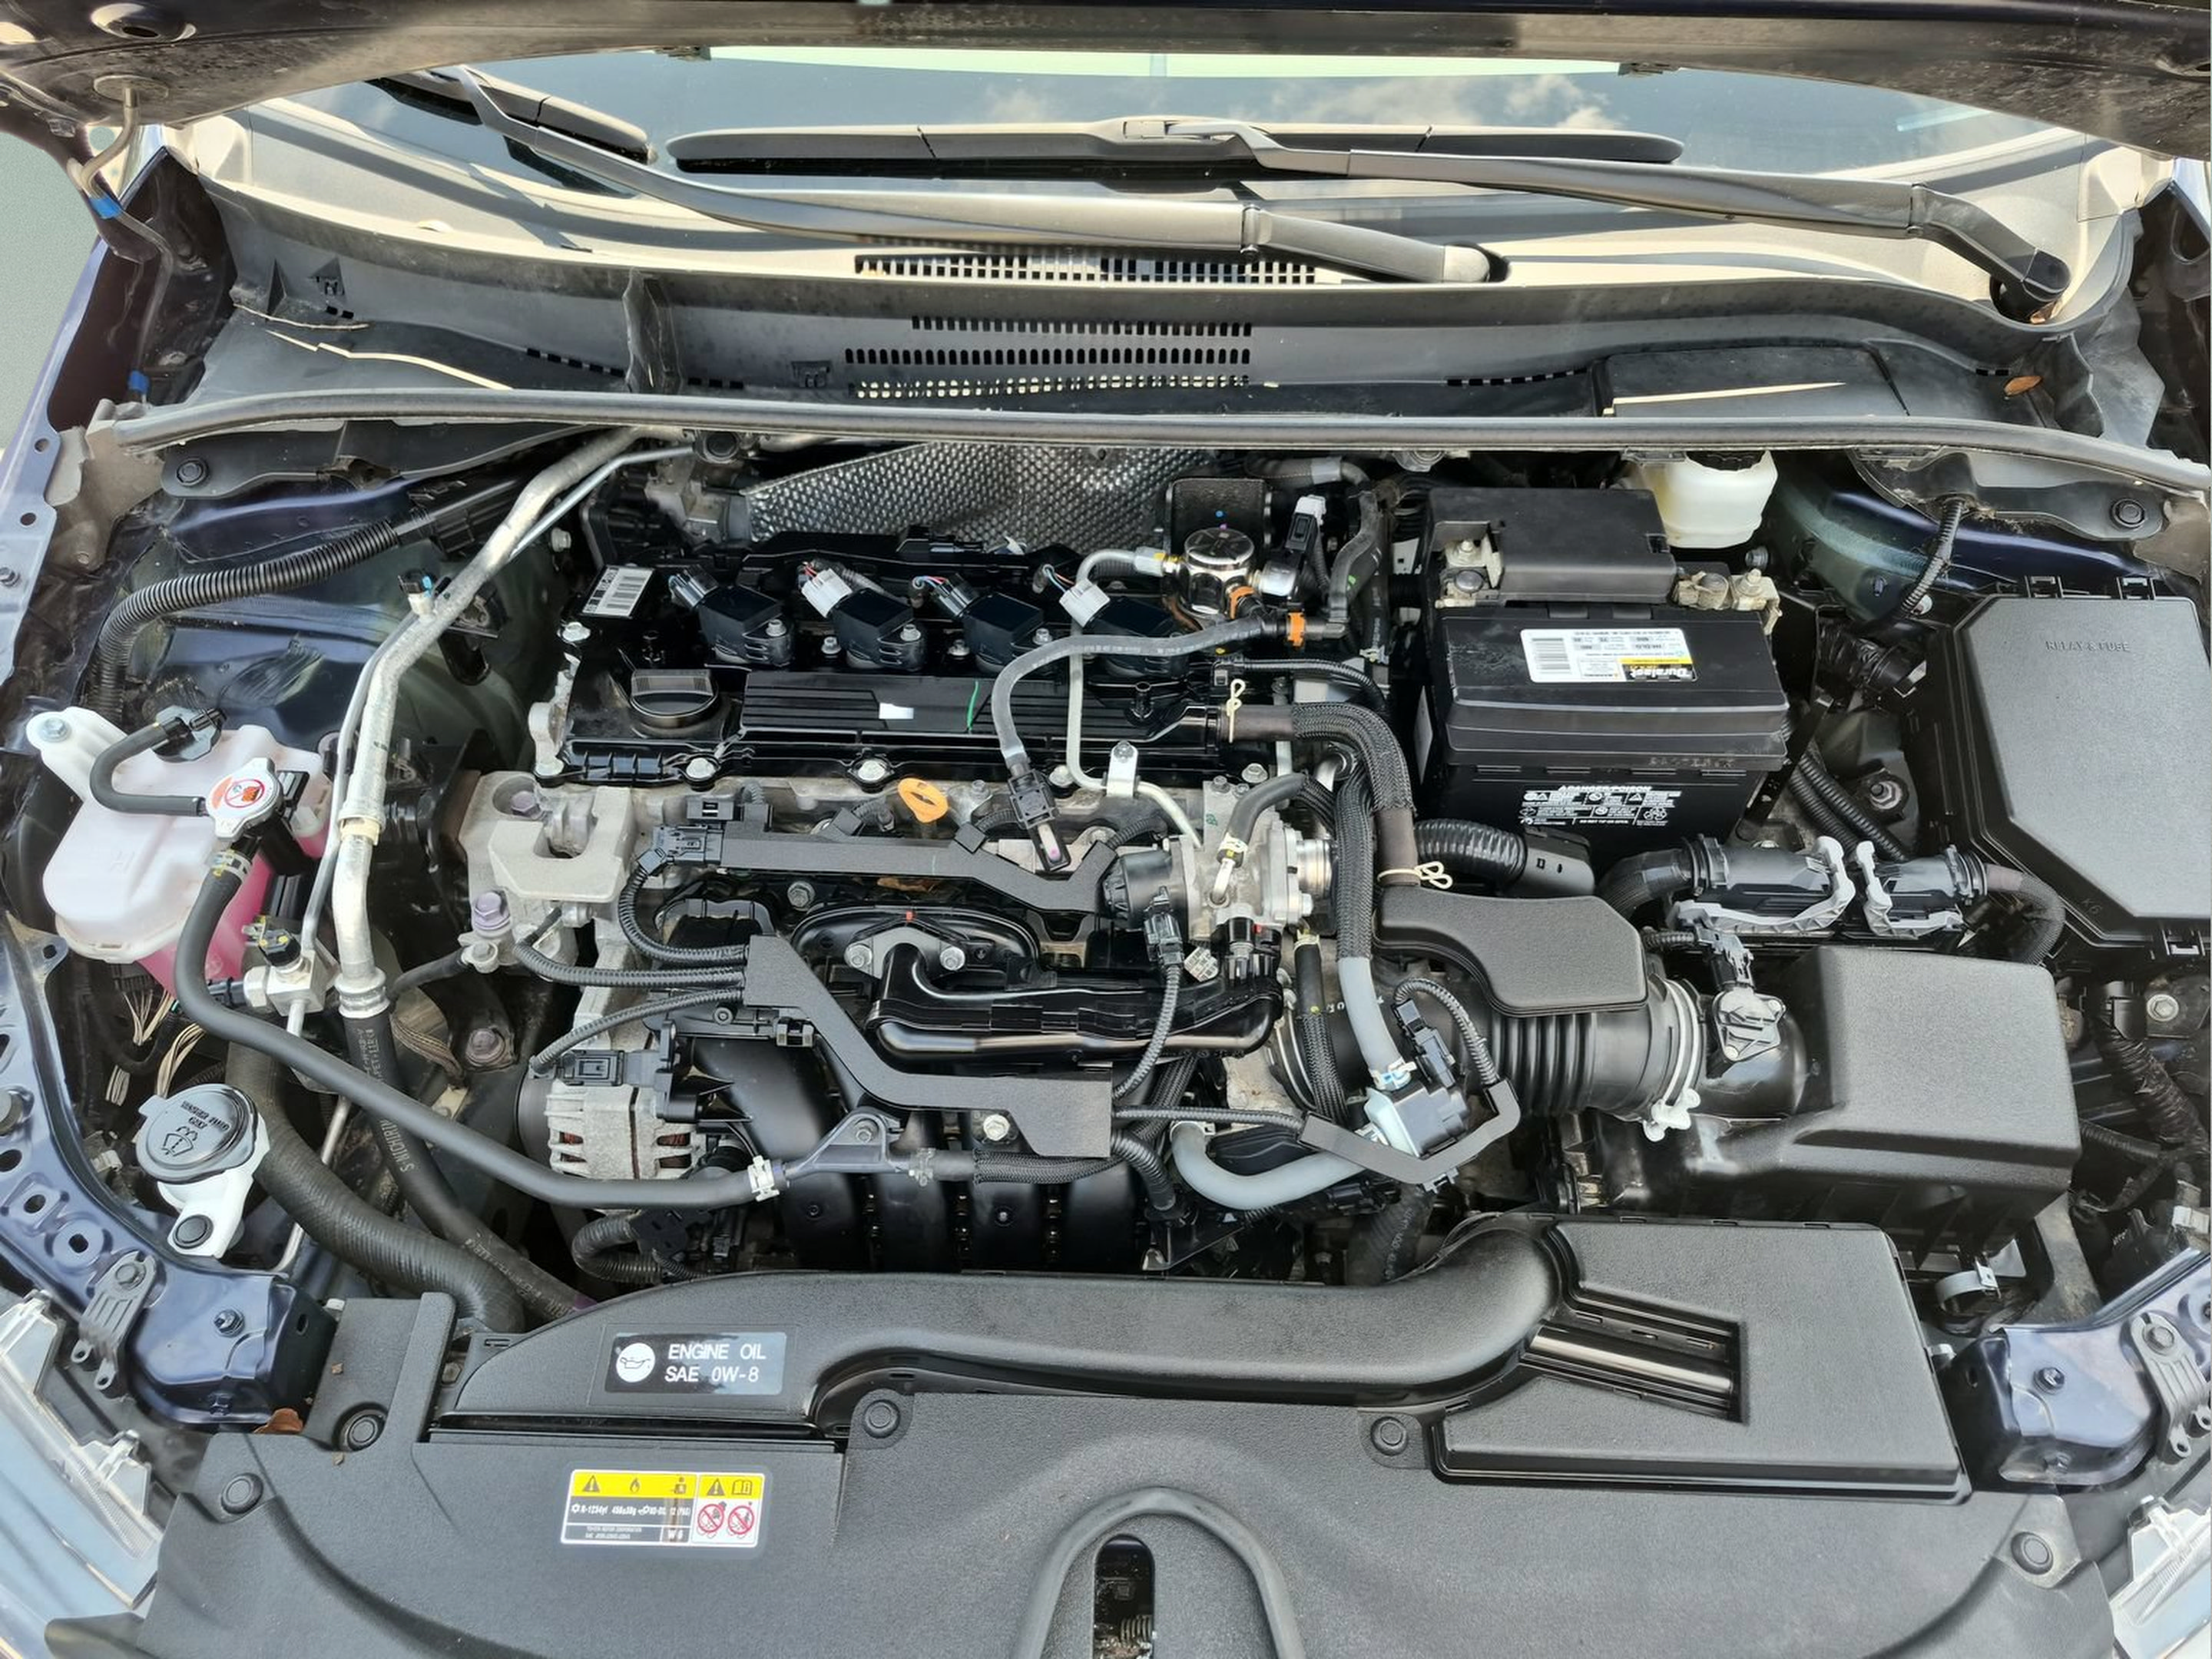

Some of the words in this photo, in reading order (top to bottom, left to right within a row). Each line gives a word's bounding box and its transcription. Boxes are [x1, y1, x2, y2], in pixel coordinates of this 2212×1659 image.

[2045, 641, 2084, 652] RELAY
[2087, 641, 2097, 652] &
[2098, 641, 2131, 653] FUSE
[1629, 666, 1689, 679] Duralast
[667, 1343, 729, 1359] ENGINE
[740, 1343, 767, 1359] OIL
[664, 1366, 698, 1382] SAE
[711, 1366, 760, 1382] 0W-8
